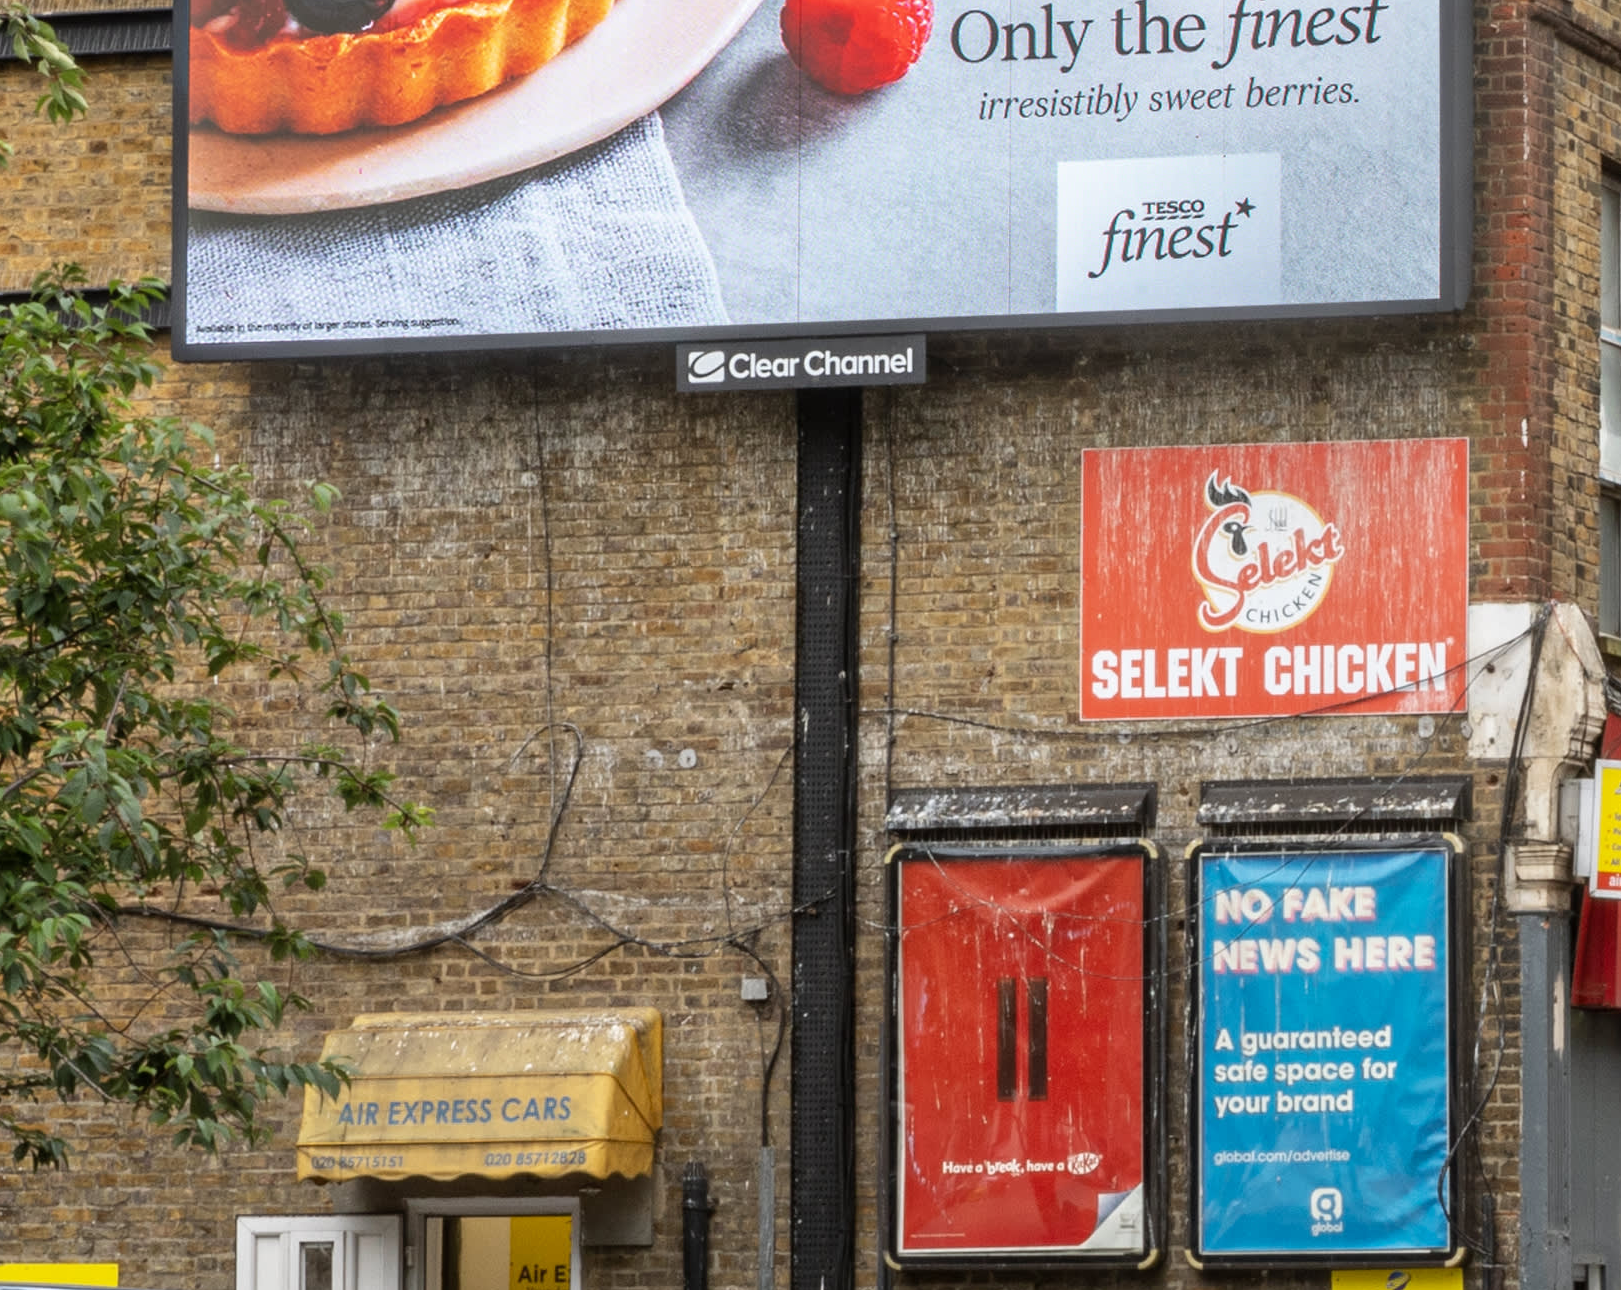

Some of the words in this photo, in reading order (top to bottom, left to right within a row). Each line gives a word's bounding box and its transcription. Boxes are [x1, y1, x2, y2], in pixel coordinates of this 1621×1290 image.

[950, 3, 1094, 73] Only
[1111, 0, 1206, 56] the
[979, 82, 1138, 122] irresistibly
[1149, 83, 1235, 112] sweet
[1246, 77, 1360, 108] berries.
[1143, 199, 1204, 216] TESCO
[1088, 209, 1239, 278] finest
[196, 324, 234, 333] Available
[237, 324, 244, 332] in
[247, 323, 261, 332] the
[264, 322, 300, 332] majority
[302, 322, 312, 330] of
[314, 321, 341, 331] larger
[343, 320, 373, 329] stores.
[375, 319, 408, 329] Serving
[411, 318, 460, 328] suggestion.
[729, 353, 799, 378] Clear
[804, 348, 913, 376] Channel
[1196, 503, 1344, 628] Selekt
[1246, 573, 1322, 624] CHICKEN
[1092, 647, 1243, 699] SELEKT
[1264, 643, 1446, 695] CHICKEN
[1611, 859, 1621, 867] All
[1215, 889, 1273, 924] NO
[1283, 886, 1376, 923] FAKE
[1213, 938, 1321, 974] NEWS
[1334, 935, 1436, 971] HERE
[1215, 1028, 1234, 1050] A
[1242, 1025, 1392, 1056] guaranteed
[1215, 1061, 1268, 1082] safe
[1275, 1062, 1355, 1085] space
[1362, 1057, 1397, 1079] for
[337, 1101, 378, 1126] AIR
[388, 1099, 492, 1126] EXPRESS
[500, 1096, 571, 1122] CARS
[1215, 1096, 1270, 1118] your
[1277, 1089, 1353, 1112] brand
[484, 1153, 512, 1167] 020
[516, 1151, 587, 1166] 85712828
[942, 1161, 973, 1174] Have
[975, 1165, 983, 1173] a
[985, 1159, 1024, 1175] break,
[1026, 1160, 1054, 1172] have
[1056, 1164, 1065, 1172] a
[1214, 1149, 1350, 1165] global.com/advertise
[1311, 1221, 1343, 1237] global
[518, 1264, 547, 1283] Air
